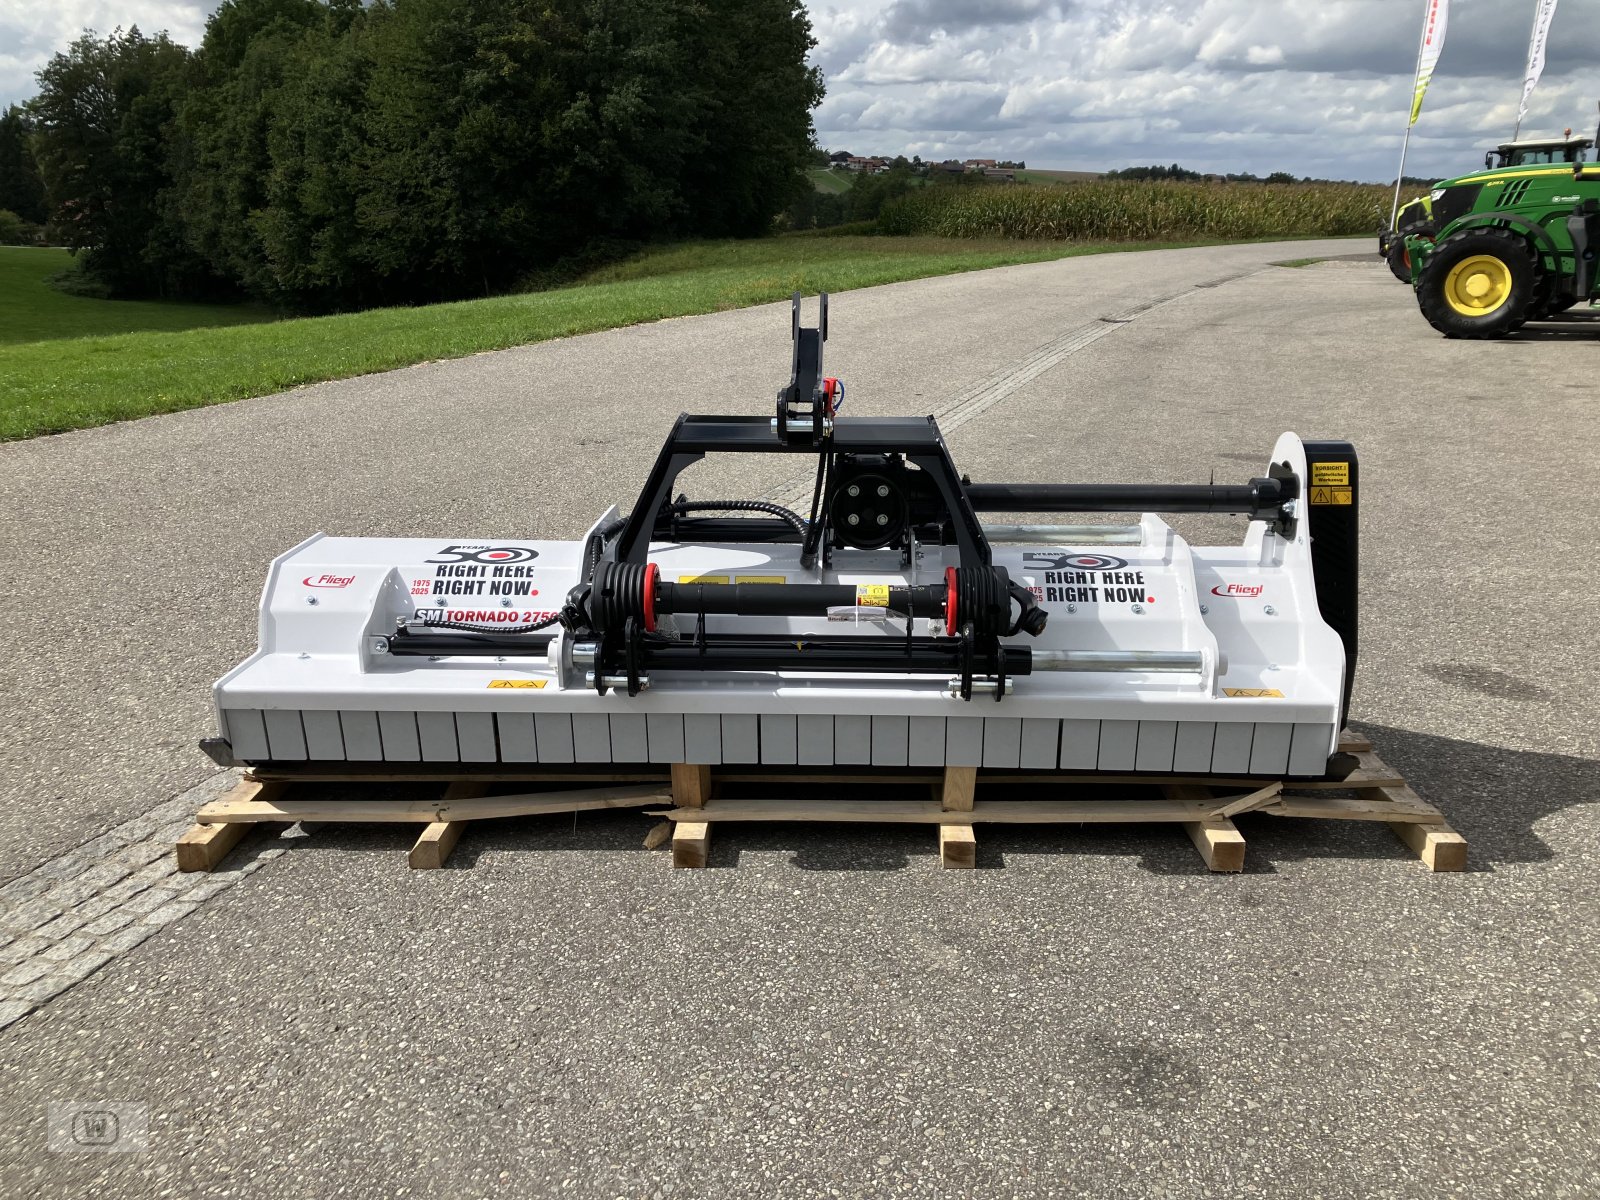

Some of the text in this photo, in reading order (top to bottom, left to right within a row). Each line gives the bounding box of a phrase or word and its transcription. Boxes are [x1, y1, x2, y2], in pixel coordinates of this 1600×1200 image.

[436, 565, 535, 577] RIGHT HERE
[318, 575, 355, 586] Fliegl
[1045, 571, 1144, 584] RIGHT HERE
[433, 580, 539, 596] RIGHT NOW.
[1228, 584, 1263, 596] Fliegl
[1047, 587, 1155, 603] RIGHT NOW.
[416, 610, 442, 621] SM
[446, 610, 519, 622] TORNADO
